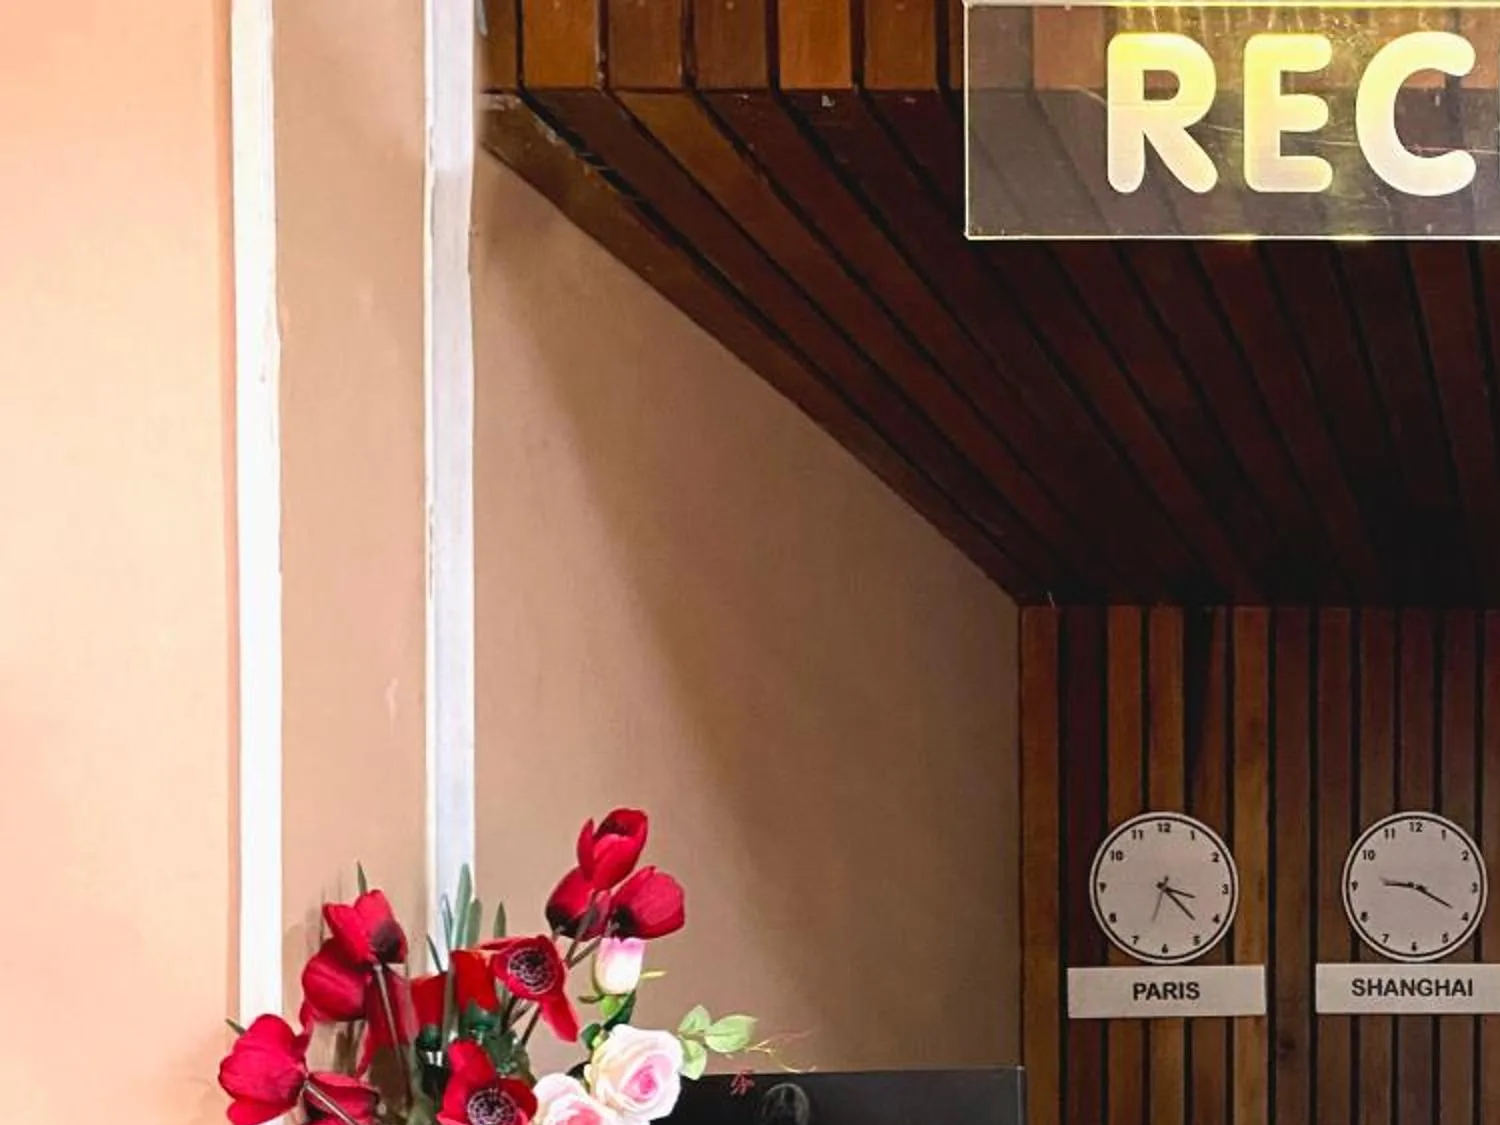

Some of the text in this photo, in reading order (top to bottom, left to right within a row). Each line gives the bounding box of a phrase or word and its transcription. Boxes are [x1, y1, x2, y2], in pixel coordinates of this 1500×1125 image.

[1157, 823, 1172, 833] 12
[1409, 822, 1422, 832] 12
[1132, 829, 1144, 840] 11
[1384, 828, 1396, 839] 11
[1110, 851, 1124, 862] 10
[1212, 852, 1220, 863] 2
[1362, 850, 1376, 860] 10
[1132, 981, 1201, 1001] PARIS
[1350, 979, 1474, 998] SHANGHAI
